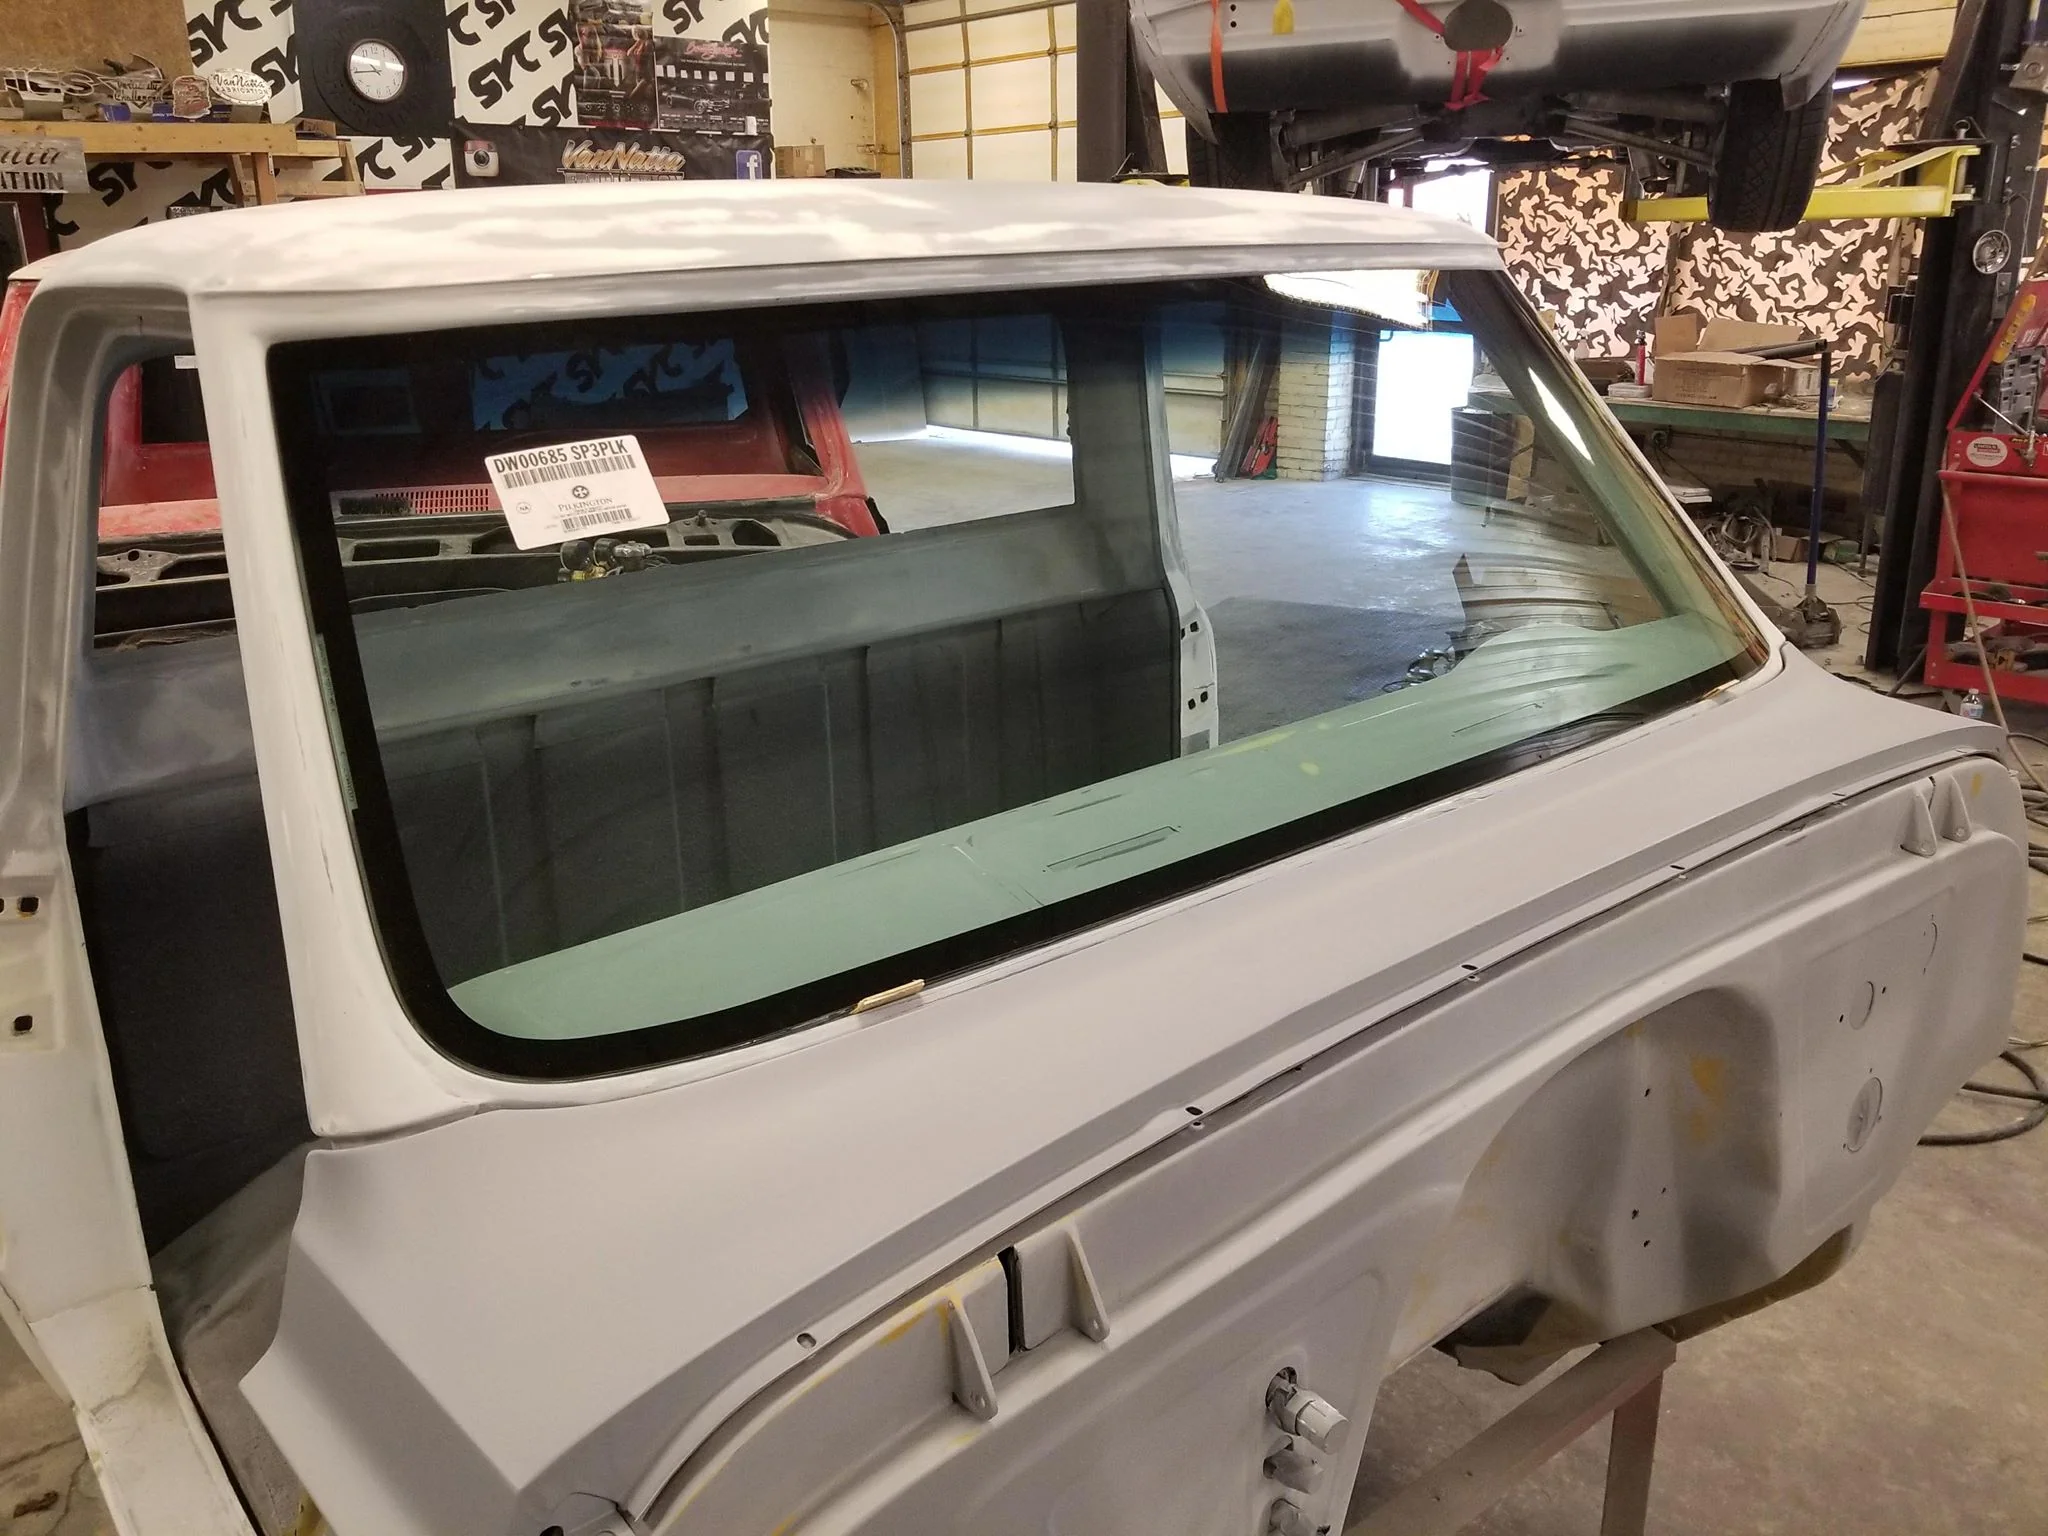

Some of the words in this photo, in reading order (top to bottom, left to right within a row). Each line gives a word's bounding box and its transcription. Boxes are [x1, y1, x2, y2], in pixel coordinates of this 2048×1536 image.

[468, 30, 541, 110] SYC
[562, 140, 686, 171] VanNatta
[493, 448, 568, 473] DW00685
[571, 439, 629, 461] SP3PLK
